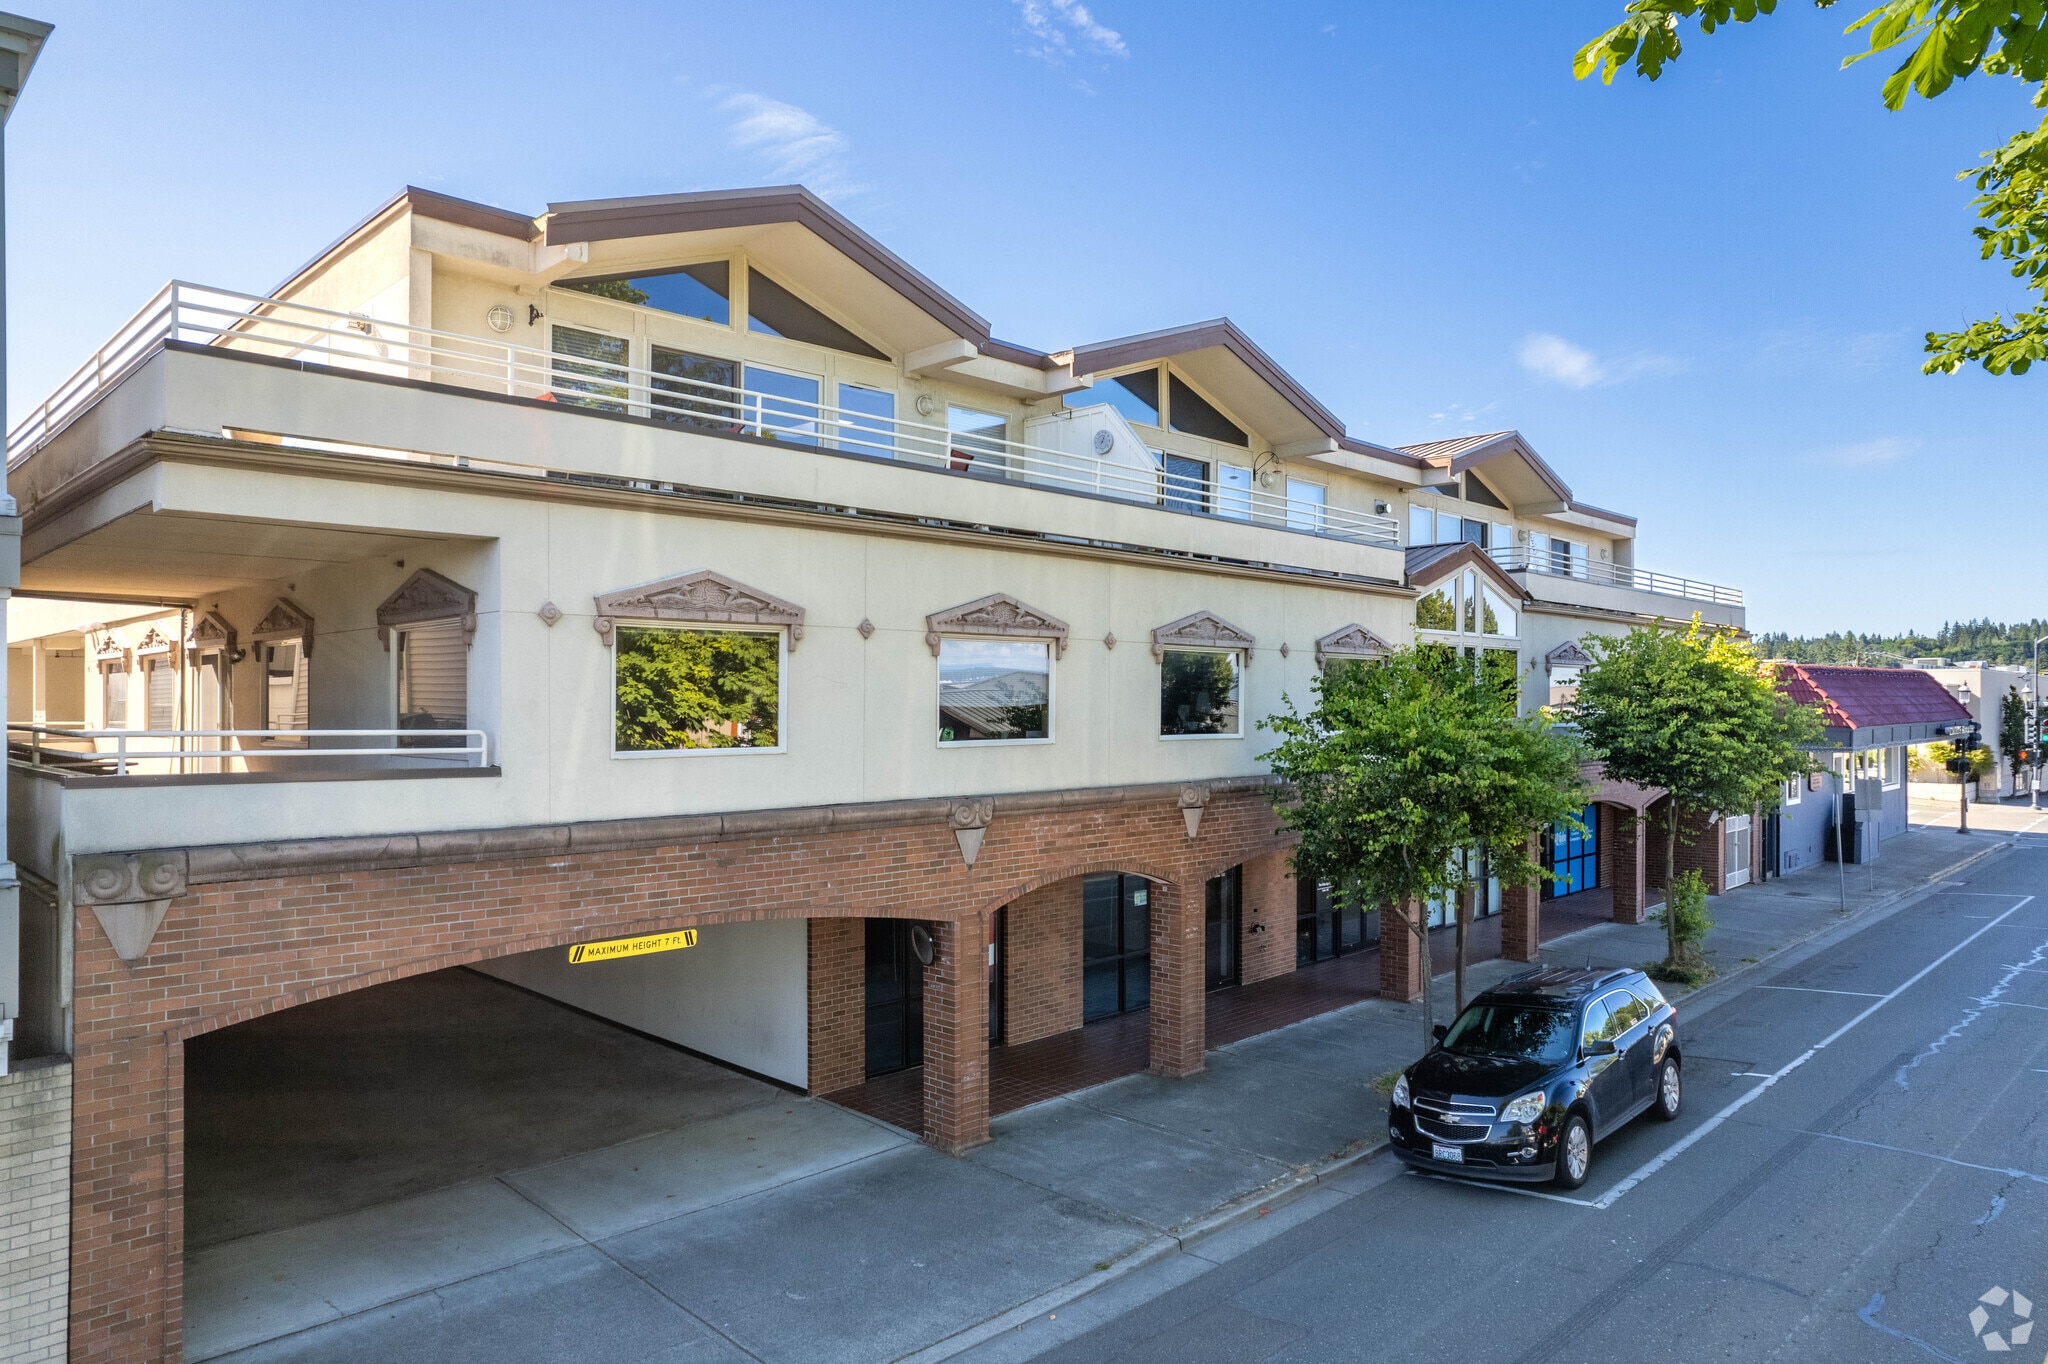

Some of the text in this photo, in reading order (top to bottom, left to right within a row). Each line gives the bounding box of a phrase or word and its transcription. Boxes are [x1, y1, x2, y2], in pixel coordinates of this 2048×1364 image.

[588, 944, 629, 956] MAXIMUM
[632, 939, 662, 950] HEIGHT
[665, 938, 669, 946] 7
